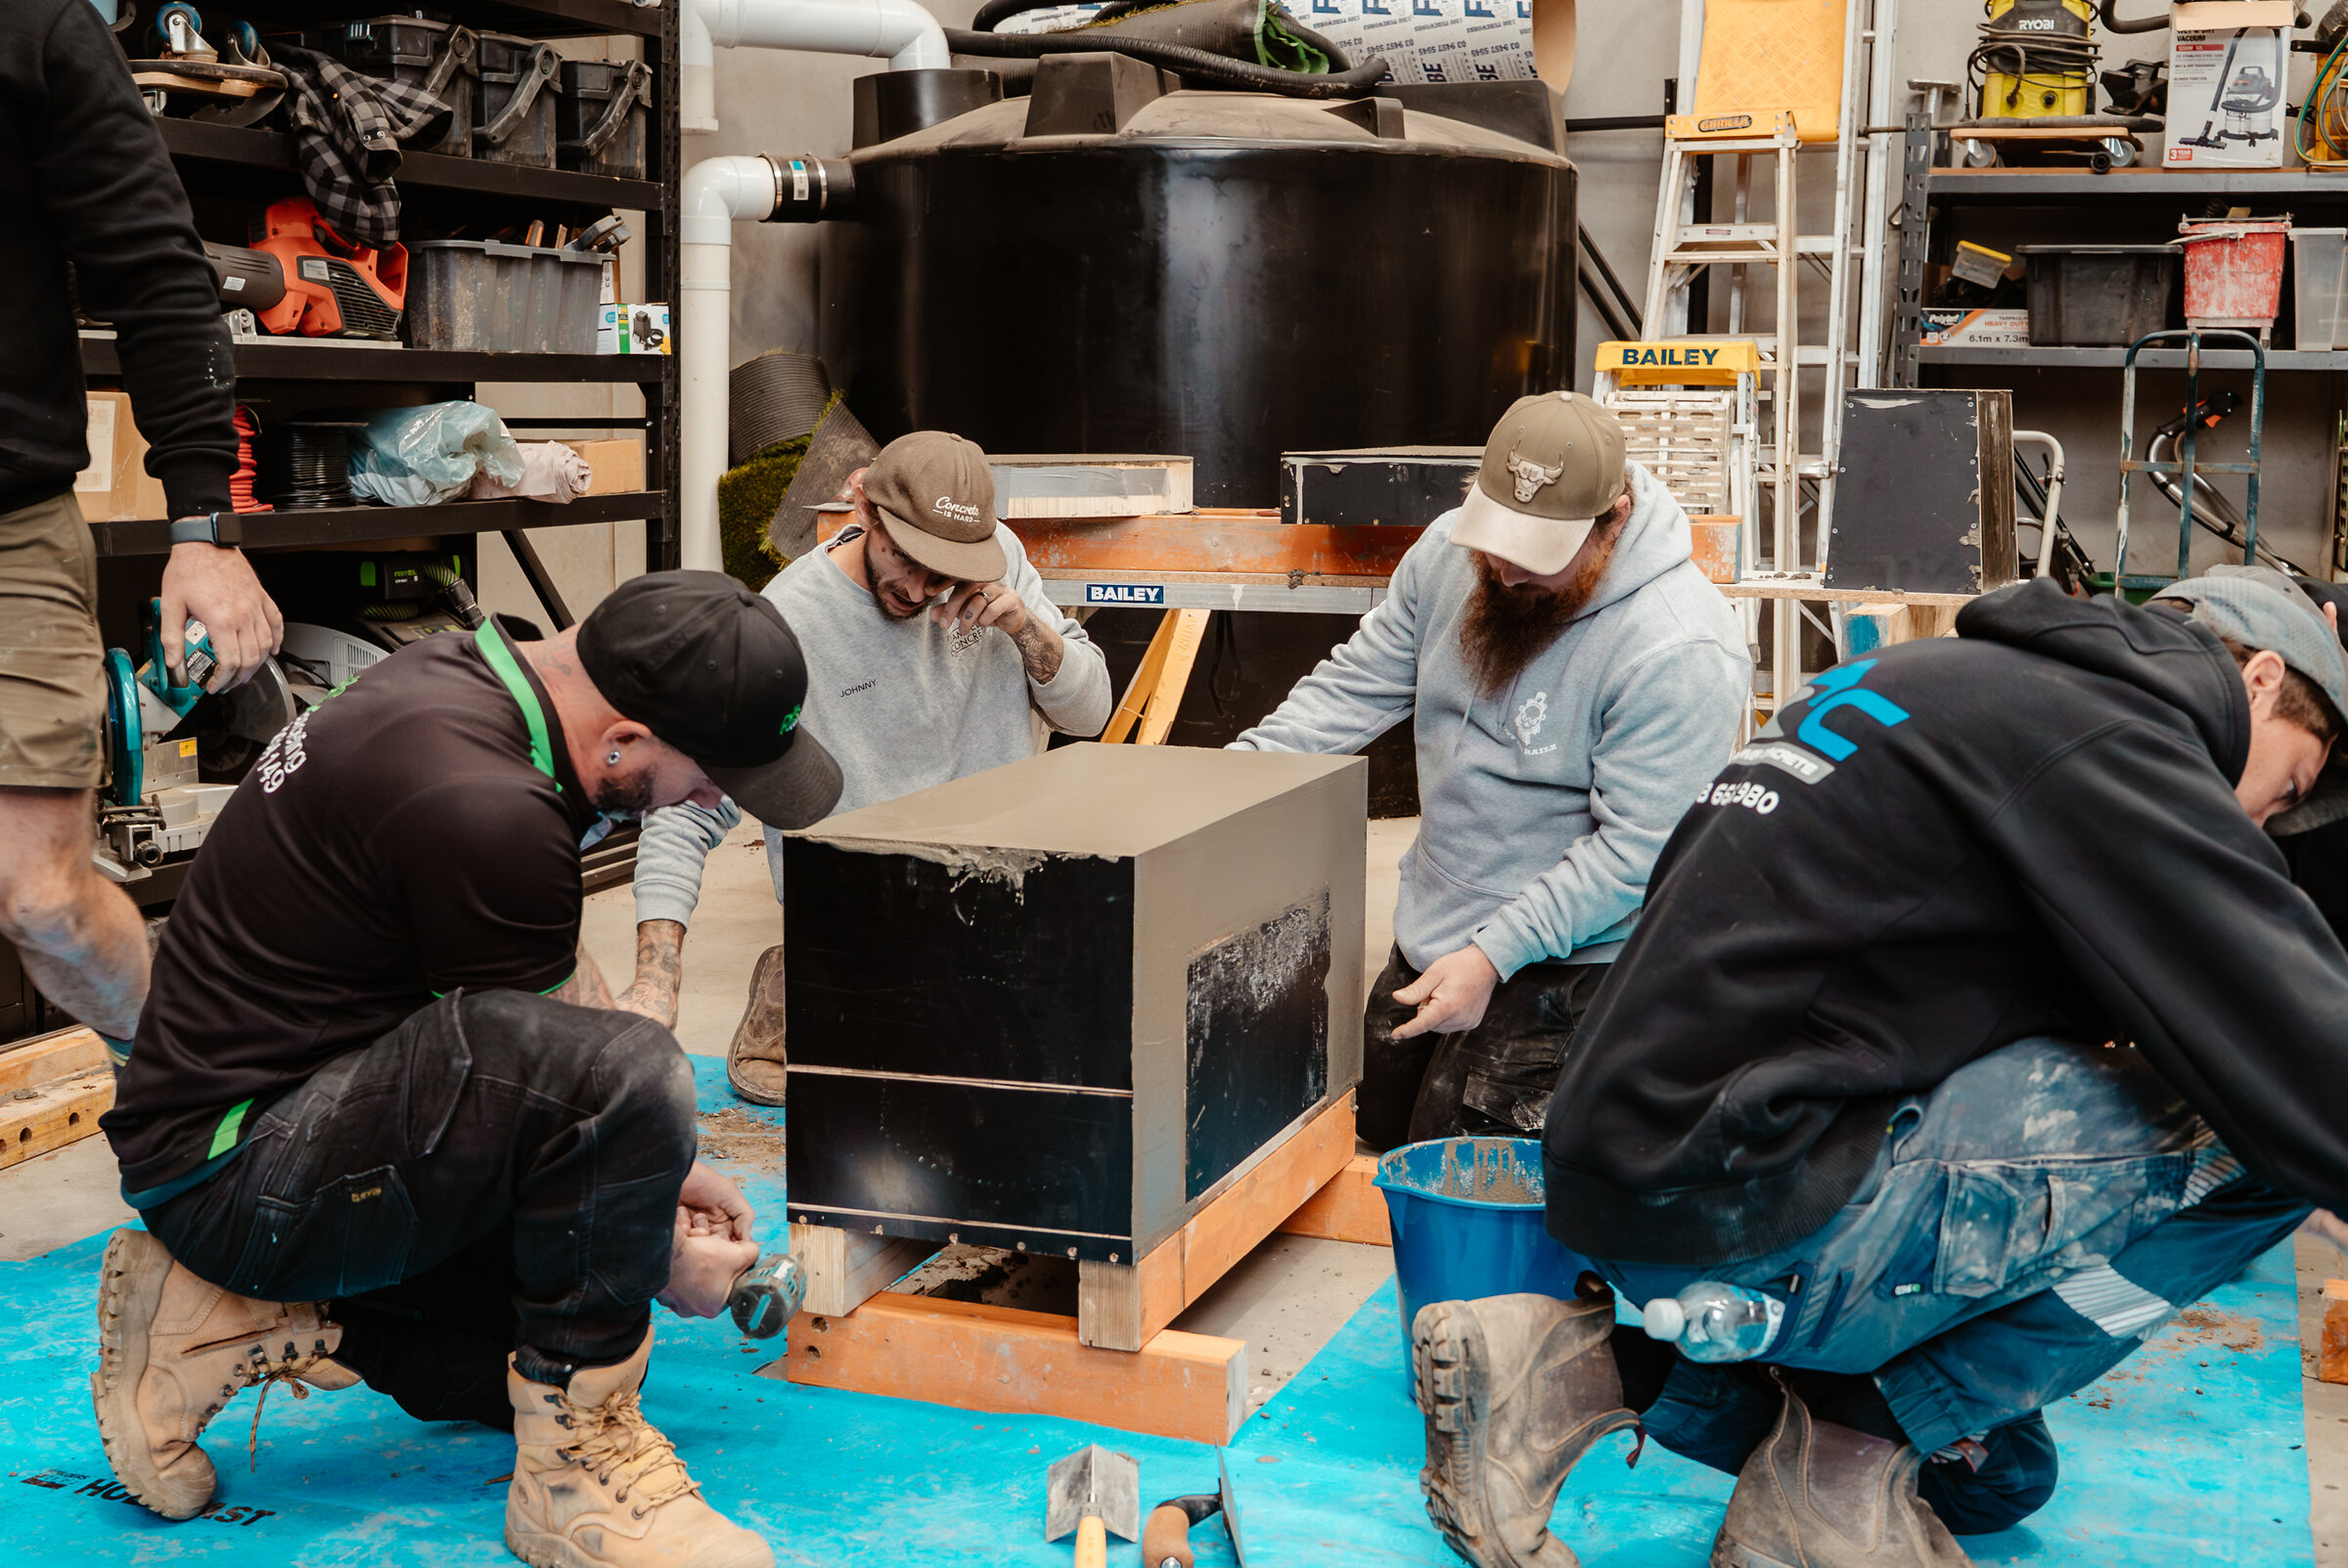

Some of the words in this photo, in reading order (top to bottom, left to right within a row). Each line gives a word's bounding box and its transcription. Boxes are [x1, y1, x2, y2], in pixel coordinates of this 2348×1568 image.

[2018, 20, 2054, 30] RYOBI
[1438, 42, 1456, 52] 9457
[1491, 43, 1509, 54] 9457
[2170, 150, 2178, 159] 3
[1969, 335, 1992, 343] 6.1m
[2005, 335, 2028, 343] 7.3m
[1622, 348, 1720, 366] BAILEY
[935, 496, 979, 516] Concrete
[953, 513, 973, 523] HARD
[1091, 586, 1158, 603] BAILEY
[839, 679, 877, 697] JOHNNY
